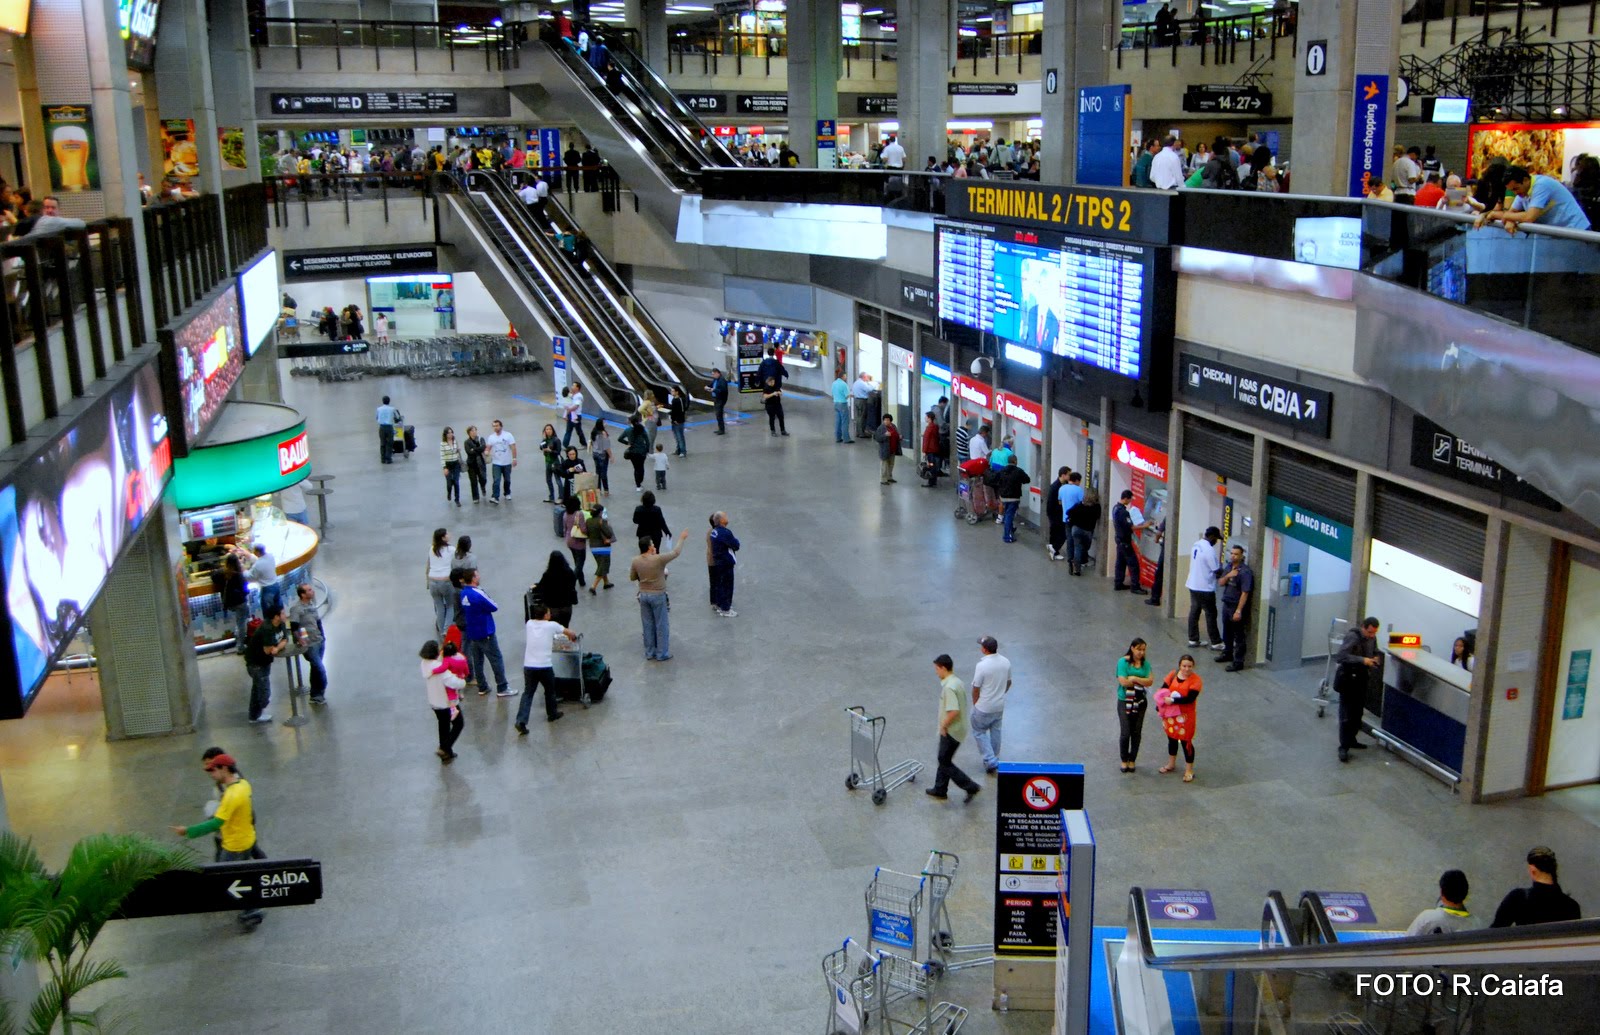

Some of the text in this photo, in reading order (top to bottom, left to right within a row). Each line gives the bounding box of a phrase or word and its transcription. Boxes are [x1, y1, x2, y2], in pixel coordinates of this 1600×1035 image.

[352, 97, 362, 108] D
[709, 98, 717, 108] D
[1218, 96, 1231, 109] 14
[1236, 97, 1251, 109] 27
[1363, 104, 1378, 146] shopping
[1364, 148, 1372, 170] aero
[968, 187, 1131, 231] TERMINAL 2 / TPS 2
[303, 256, 346, 264] DESEMBARQUE
[1202, 366, 1232, 385] CHECK-IN
[1239, 378, 1301, 419] ASAS C/B/A
[1239, 392, 1257, 406] WINGS
[1129, 451, 1165, 478] Santander
[1456, 456, 1501, 480] TERMINAL 1
[1295, 512, 1338, 539] BANCO REAL
[260, 871, 309, 886] SAÍDA
[261, 887, 290, 898] EXIT
